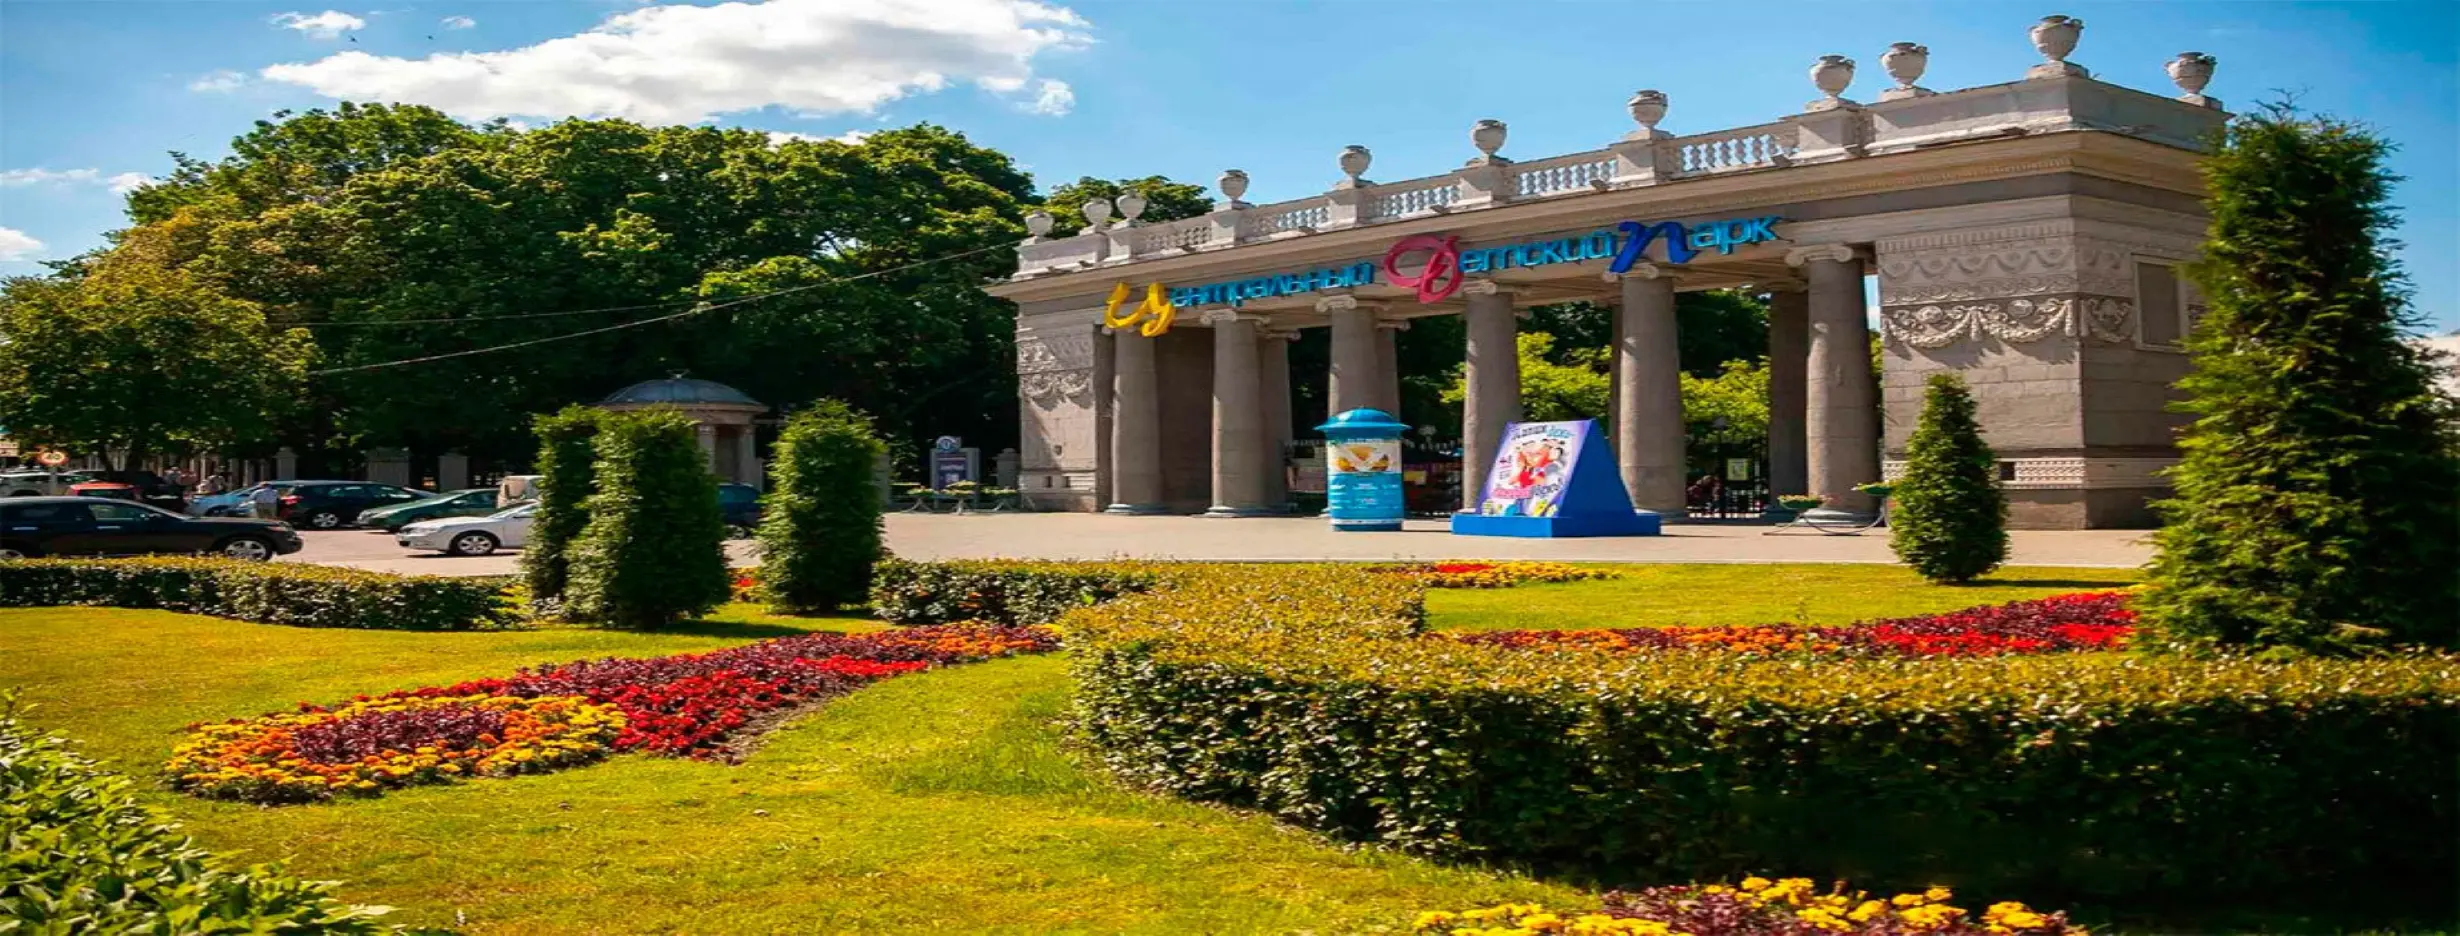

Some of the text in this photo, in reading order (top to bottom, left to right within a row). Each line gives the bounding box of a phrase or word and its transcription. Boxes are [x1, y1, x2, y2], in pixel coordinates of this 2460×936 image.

[1105, 216, 1782, 337] Центральный Детский Парк
